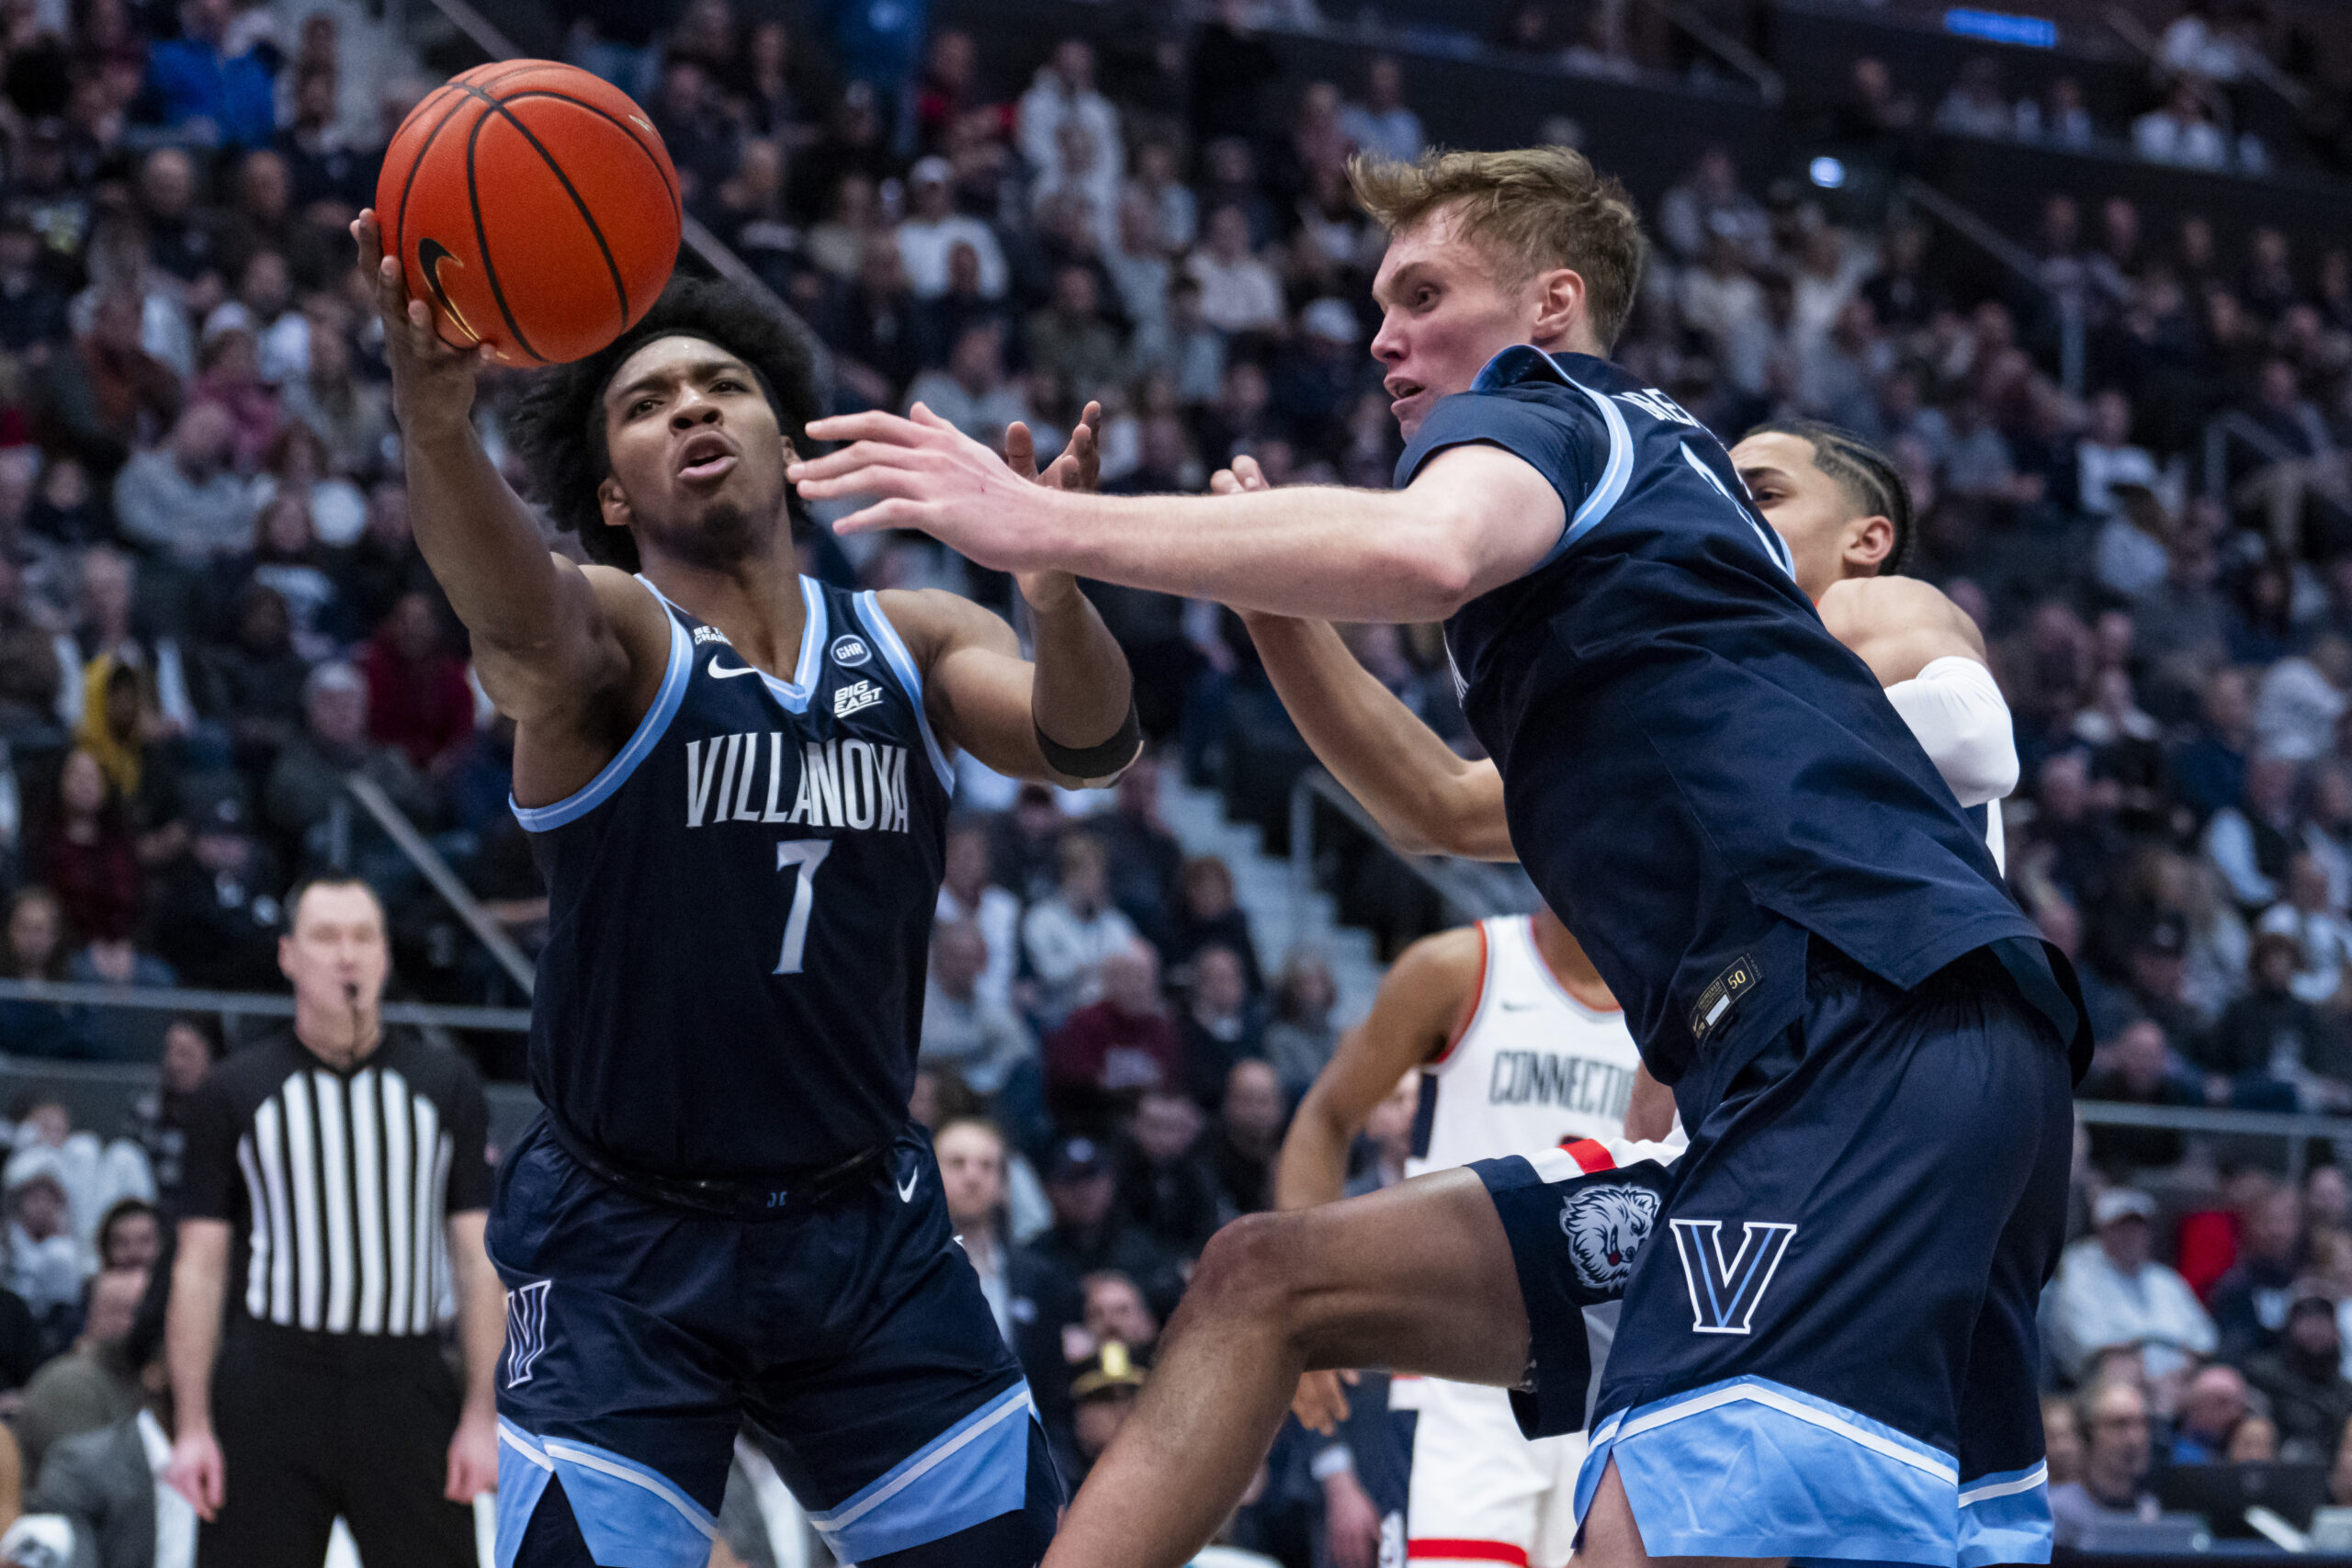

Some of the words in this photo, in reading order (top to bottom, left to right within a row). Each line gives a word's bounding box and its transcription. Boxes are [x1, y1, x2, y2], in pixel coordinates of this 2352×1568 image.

[694, 626, 711, 636] BE
[836, 642, 865, 660] GHR
[834, 680, 869, 703] BIG
[834, 686, 883, 714] EAST
[685, 732, 909, 833] VILLANOVA
[772, 839, 833, 975] 7
[1727, 970, 1747, 989] 50
[1669, 1218, 1798, 1335] V
